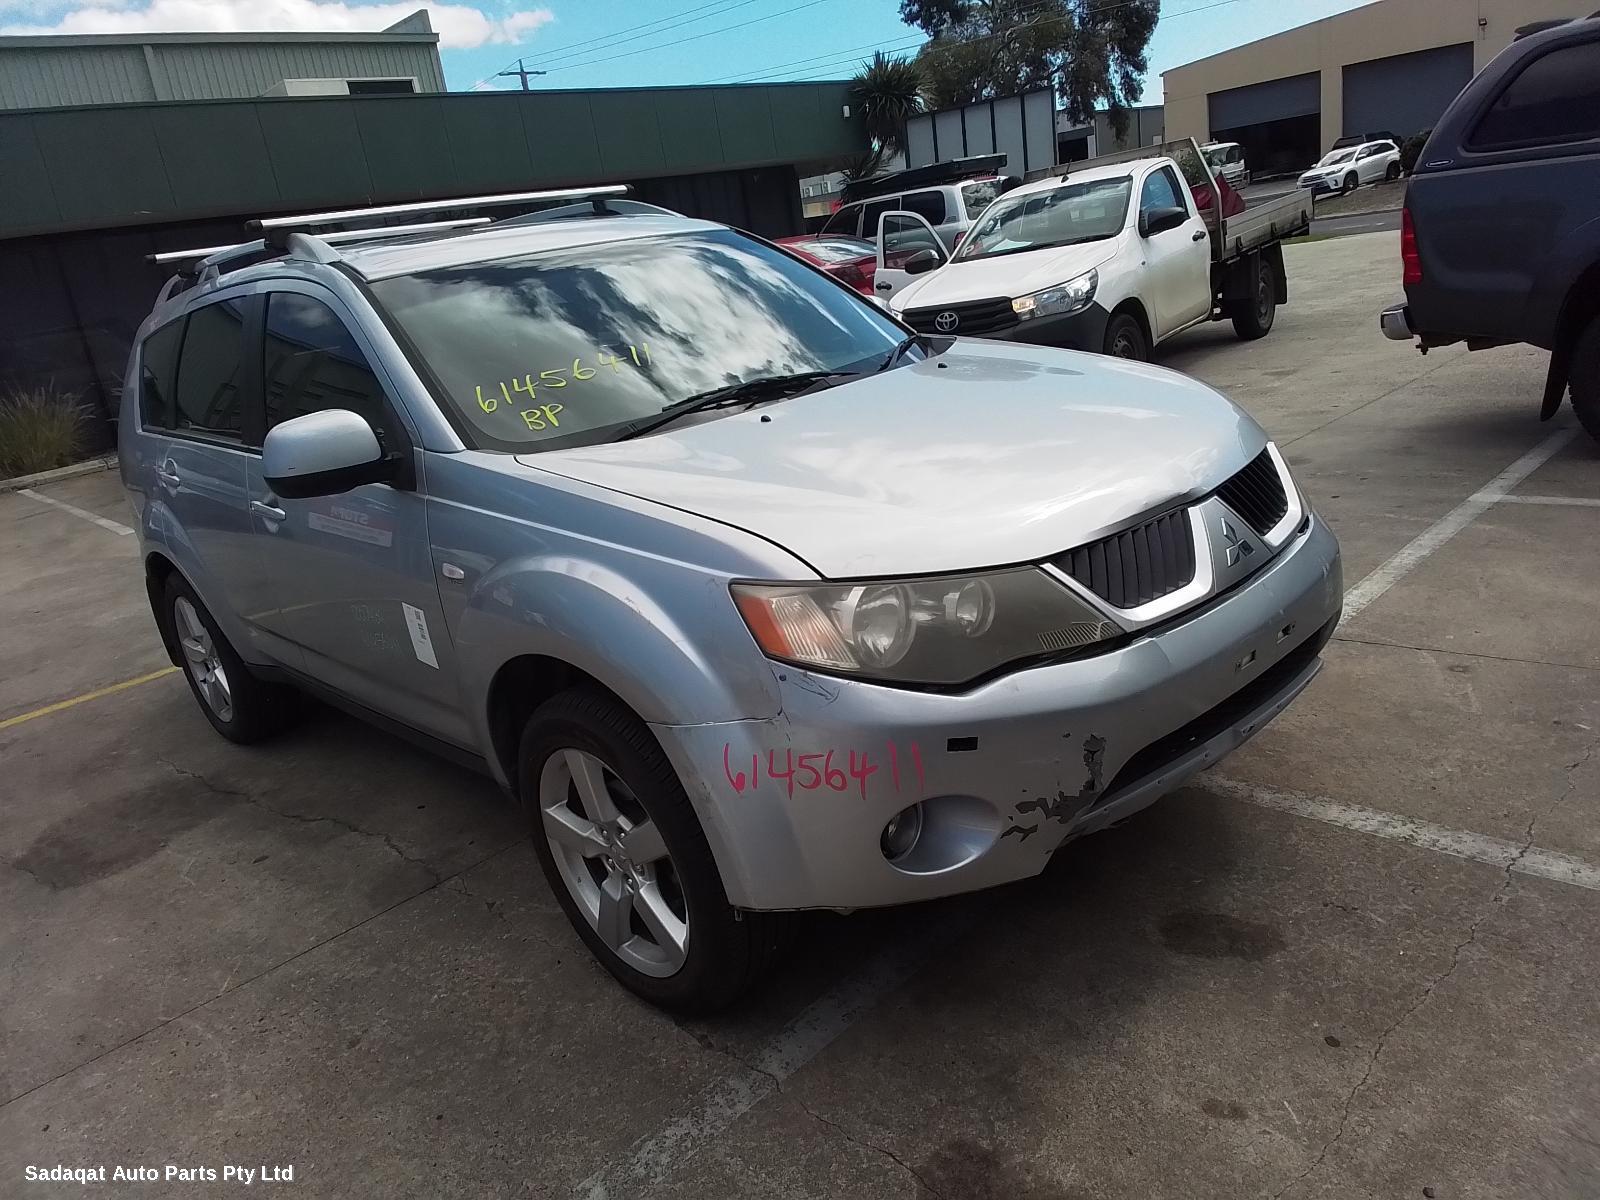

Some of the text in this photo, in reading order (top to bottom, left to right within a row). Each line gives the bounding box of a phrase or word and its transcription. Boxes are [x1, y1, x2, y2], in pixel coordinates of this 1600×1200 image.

[475, 342, 652, 414] 61456411
[520, 403, 564, 431] BP
[723, 738, 925, 801] 61456411
